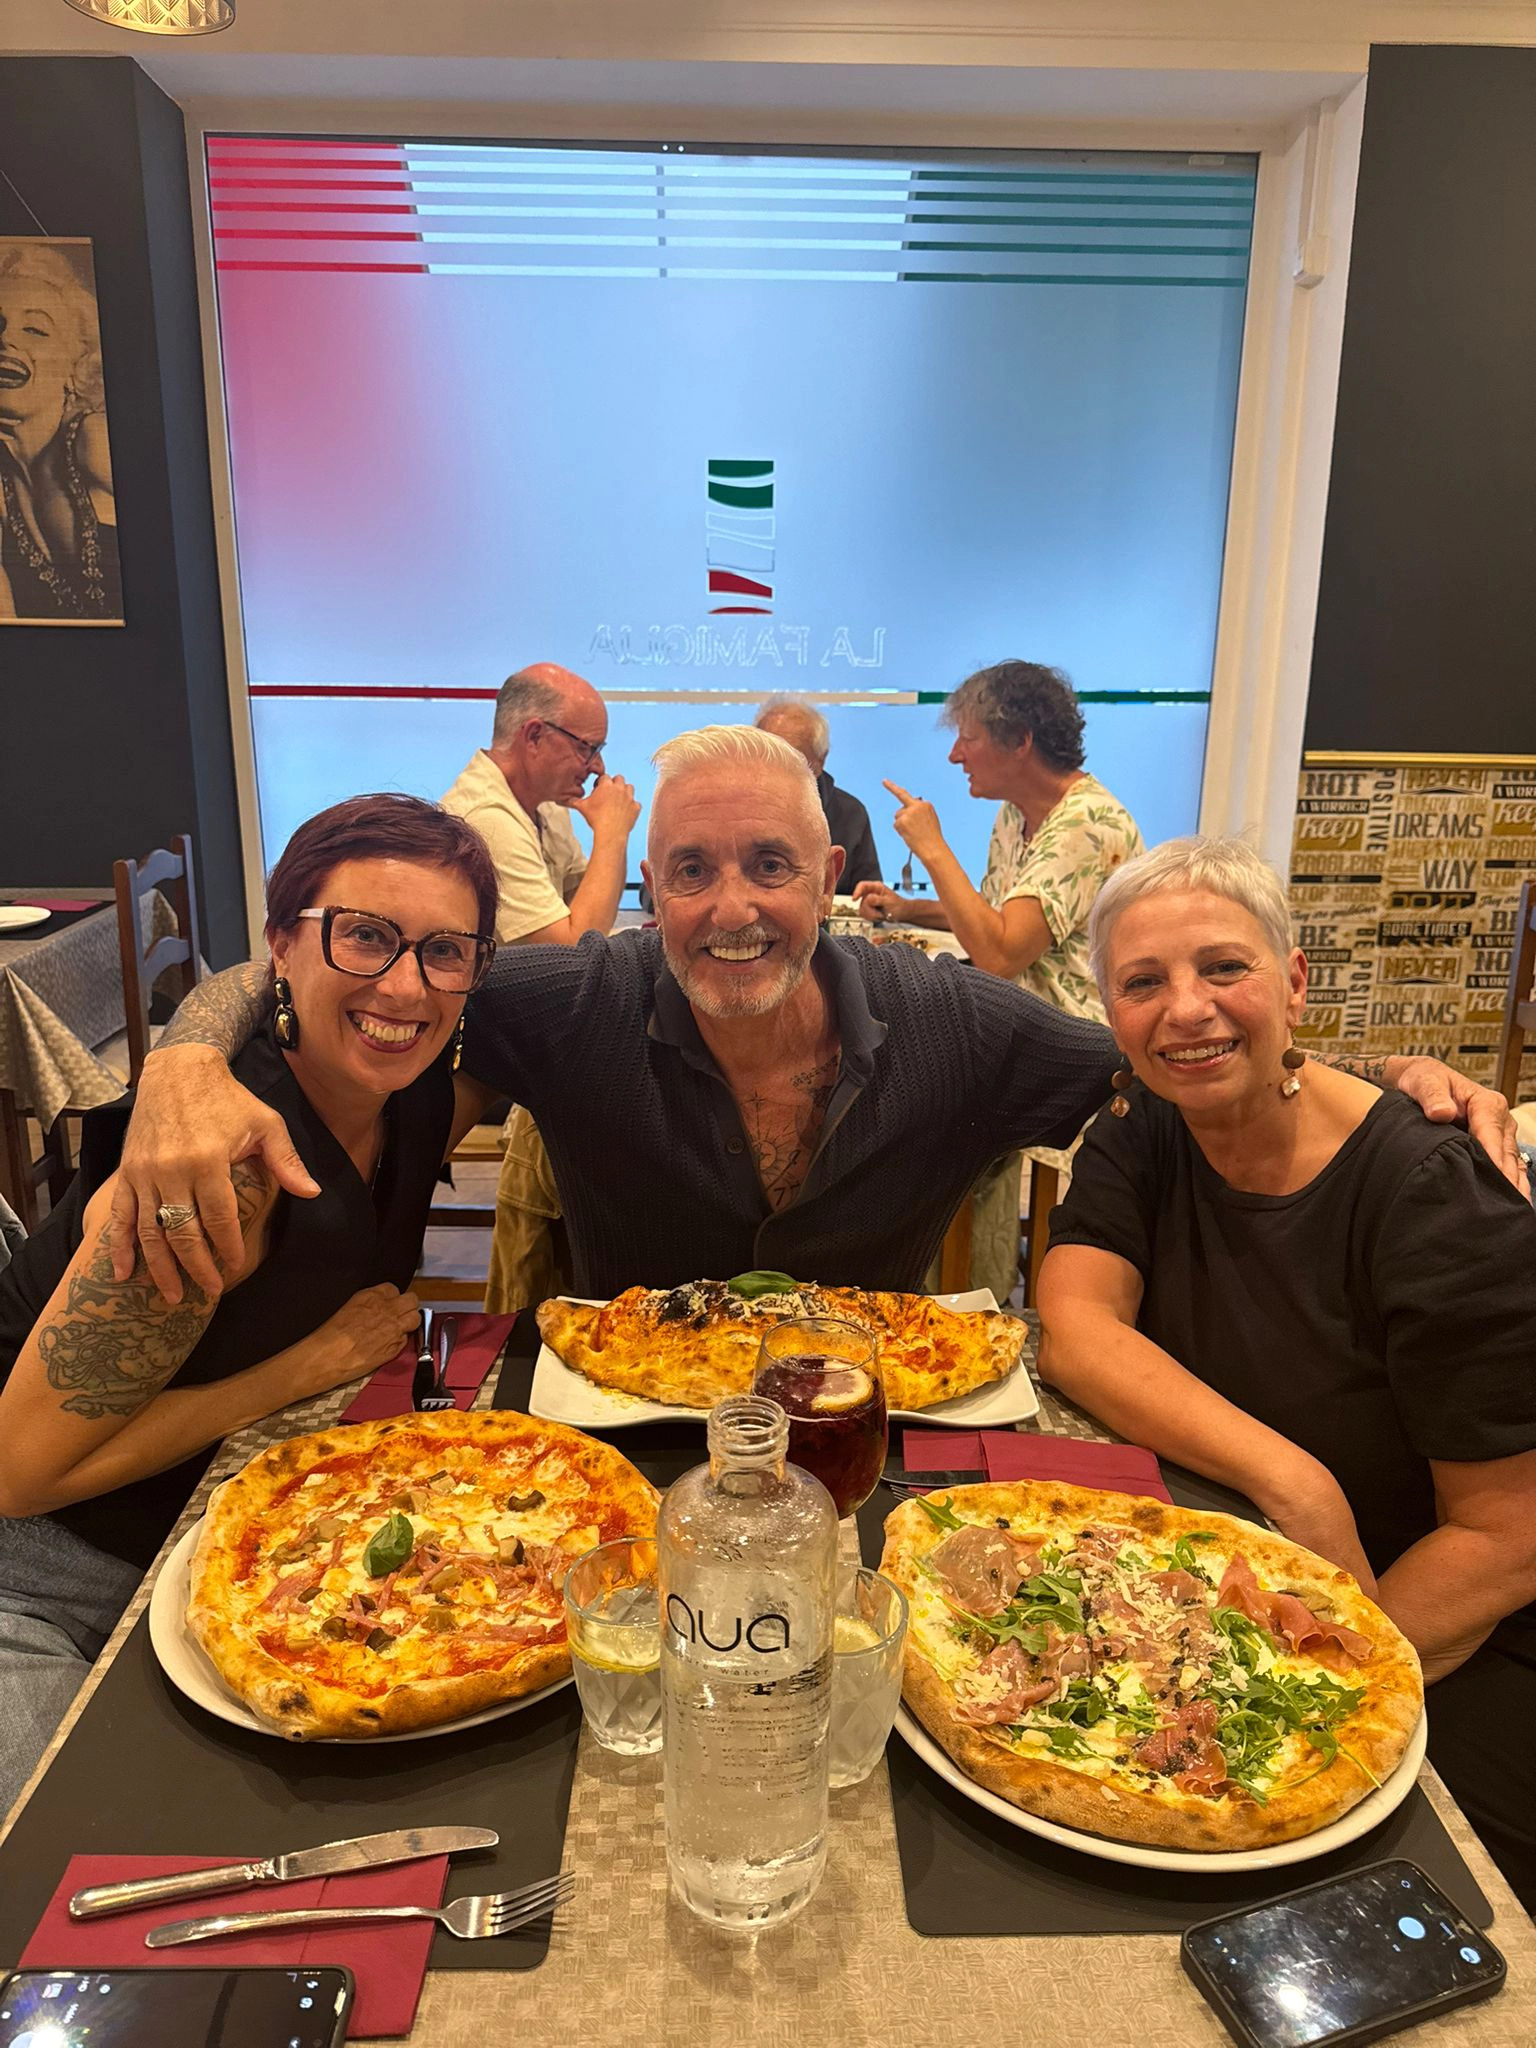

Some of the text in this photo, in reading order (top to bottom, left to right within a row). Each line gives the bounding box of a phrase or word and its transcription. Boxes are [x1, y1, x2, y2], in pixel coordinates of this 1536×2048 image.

[1305, 773, 1367, 796] NOT
[1393, 813, 1486, 838] DREAMS
[1495, 803, 1536, 831] kee
[1300, 817, 1360, 846] keep
[1423, 859, 1478, 889] WAY
[1299, 925, 1338, 946] BE
[1382, 922, 1468, 937] SOMETIMES
[1383, 956, 1457, 980] NEVER
[1475, 951, 1512, 972] NO
[1307, 966, 1344, 987] OT
[1343, 961, 1373, 1039] POSITIVE
[1301, 1010, 1337, 1033] eep
[1370, 1002, 1459, 1026] DREAMS
[720, 1668, 769, 1676] water
